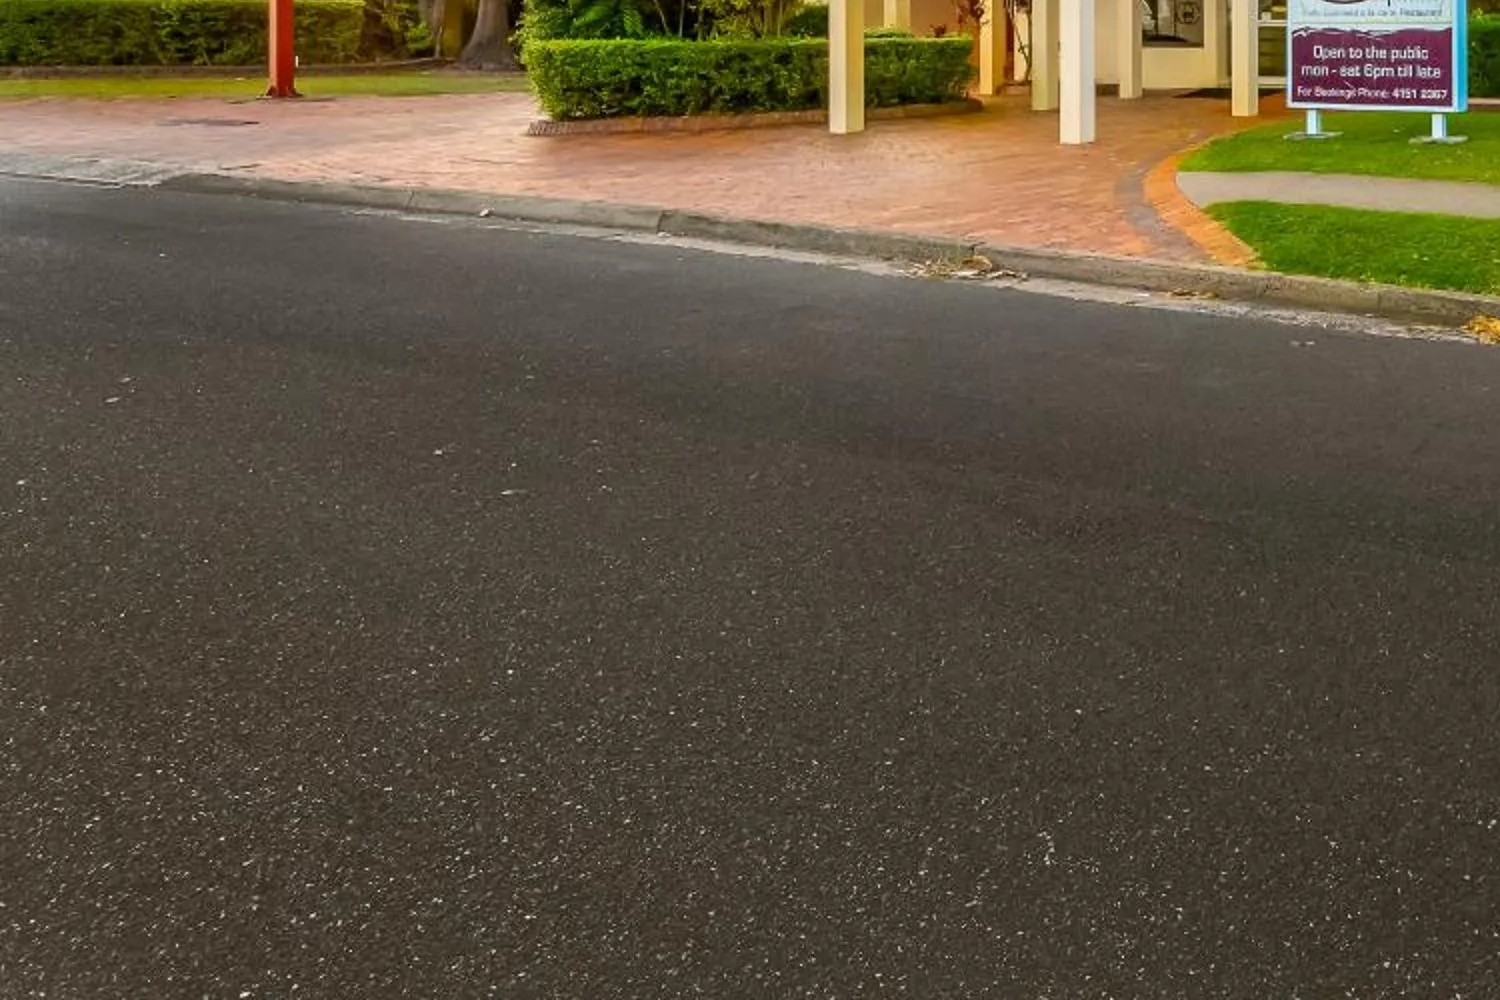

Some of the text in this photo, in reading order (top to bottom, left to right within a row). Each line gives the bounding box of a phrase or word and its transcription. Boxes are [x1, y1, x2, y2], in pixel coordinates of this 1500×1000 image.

[1313, 45, 1429, 62] Open to the public
[1301, 65, 1329, 77] mon
[1363, 63, 1395, 80] 6pm
[1397, 64, 1413, 78] till
[1415, 64, 1441, 78] late
[1297, 85, 1312, 96] For
